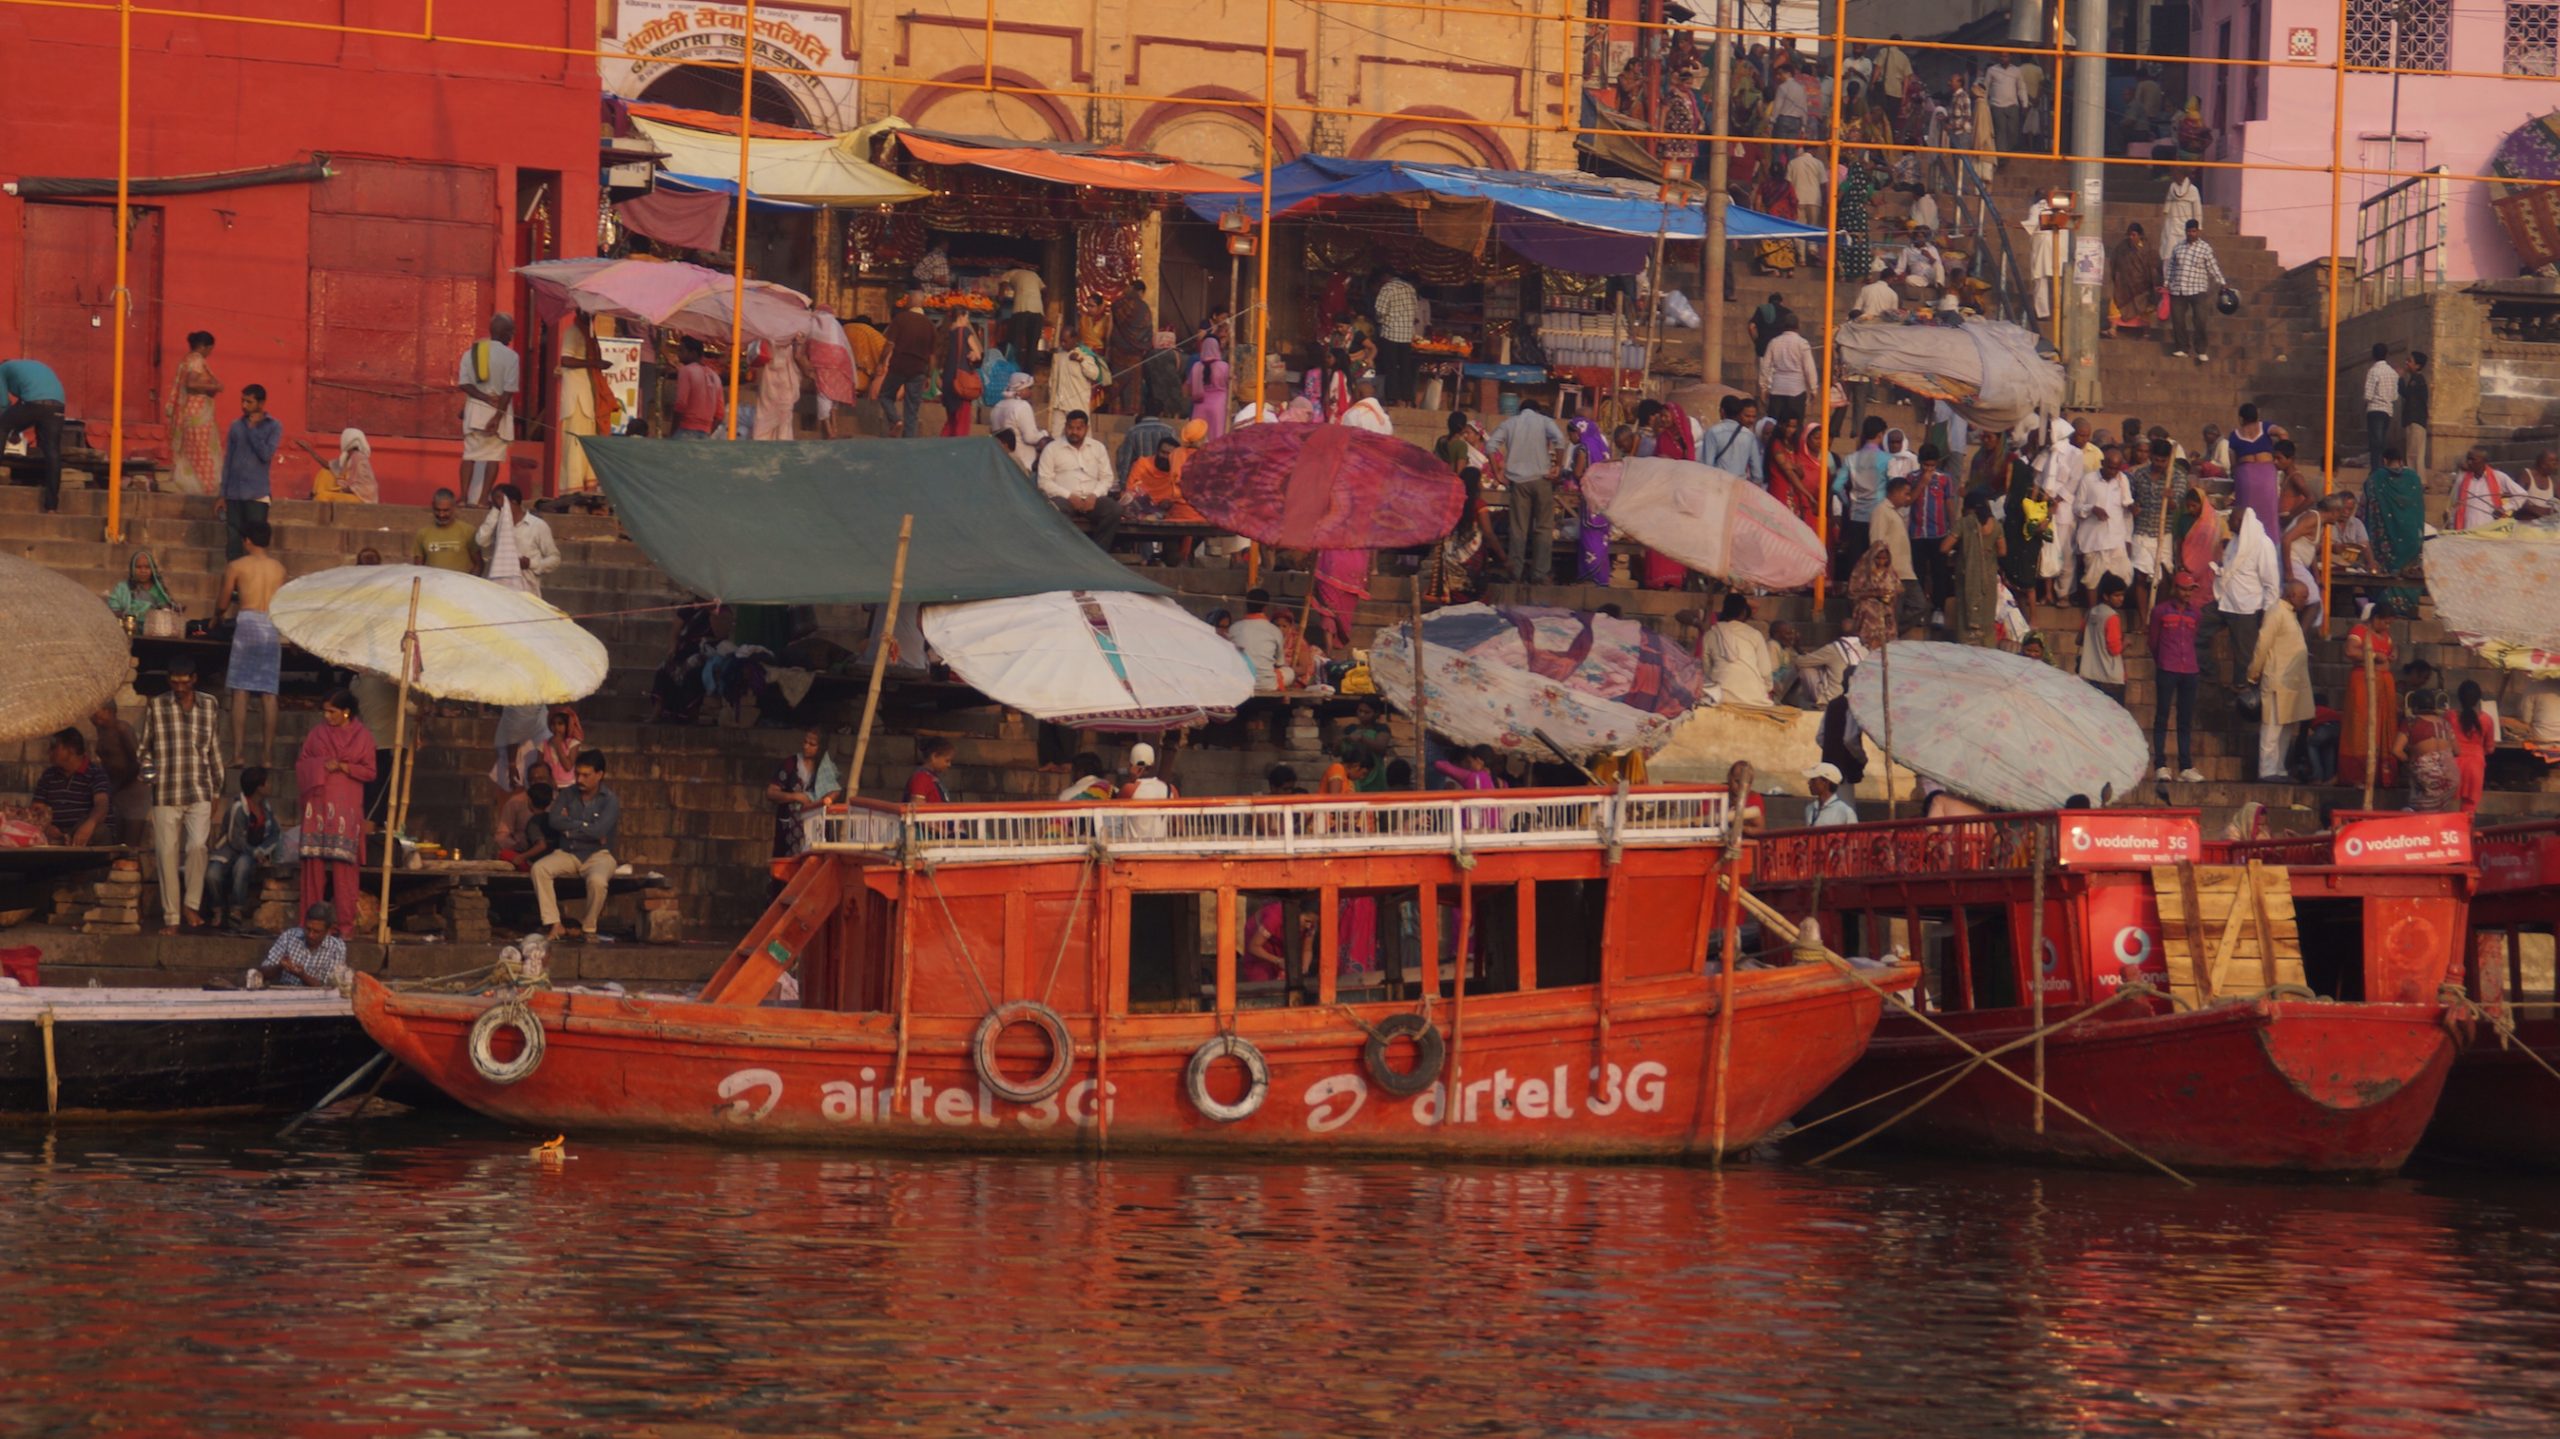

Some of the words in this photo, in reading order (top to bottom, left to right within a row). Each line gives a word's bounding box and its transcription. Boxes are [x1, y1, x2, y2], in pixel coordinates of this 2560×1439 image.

[2095, 835, 2159, 849] vodafone
[2168, 836, 2188, 850] 3G
[2366, 833, 2431, 851] vodafone
[2440, 830, 2459, 845] 3G
[2098, 971, 2168, 986] voone
[820, 1066, 1000, 1128] airtel
[1412, 1064, 1574, 1126] airtel
[1586, 1061, 1668, 1116] 3G
